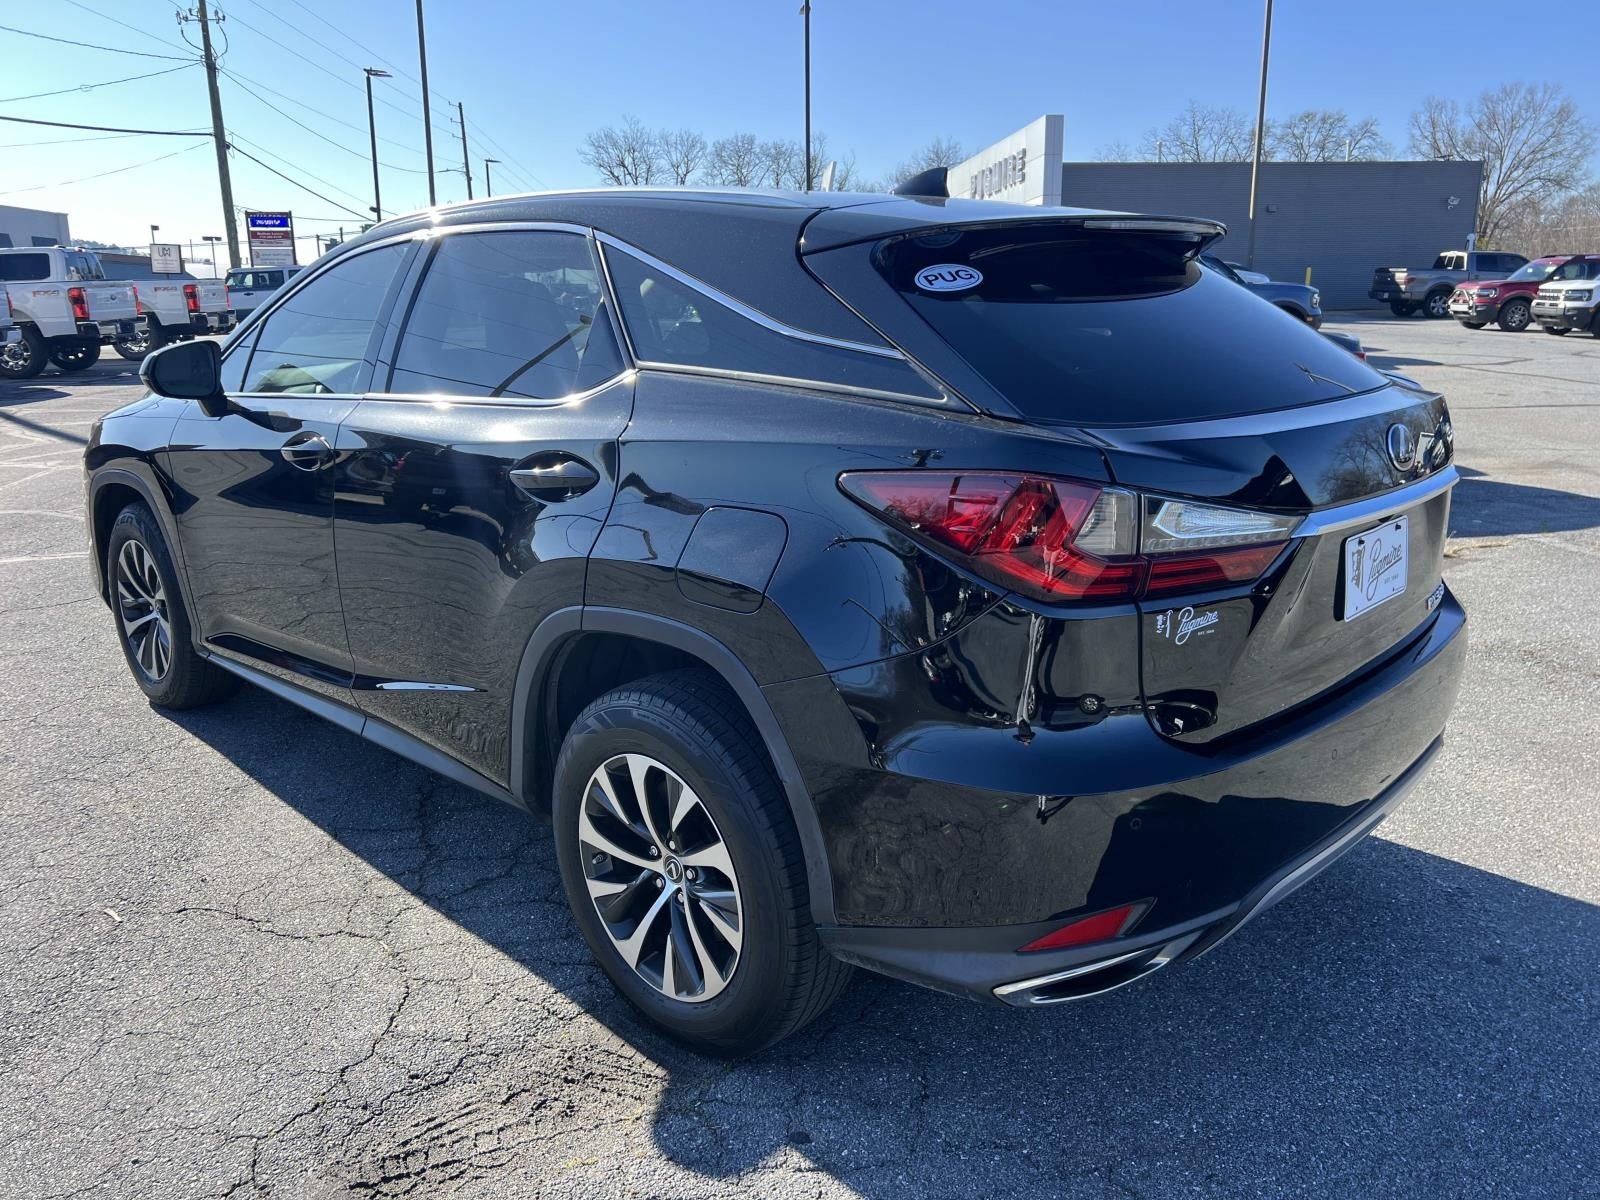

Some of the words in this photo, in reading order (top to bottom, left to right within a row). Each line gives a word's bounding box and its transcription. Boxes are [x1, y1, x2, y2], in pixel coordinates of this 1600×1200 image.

[923, 269, 975, 286] PUG
[1366, 538, 1402, 601] Pugmire
[1175, 607, 1218, 645] Pugmire
